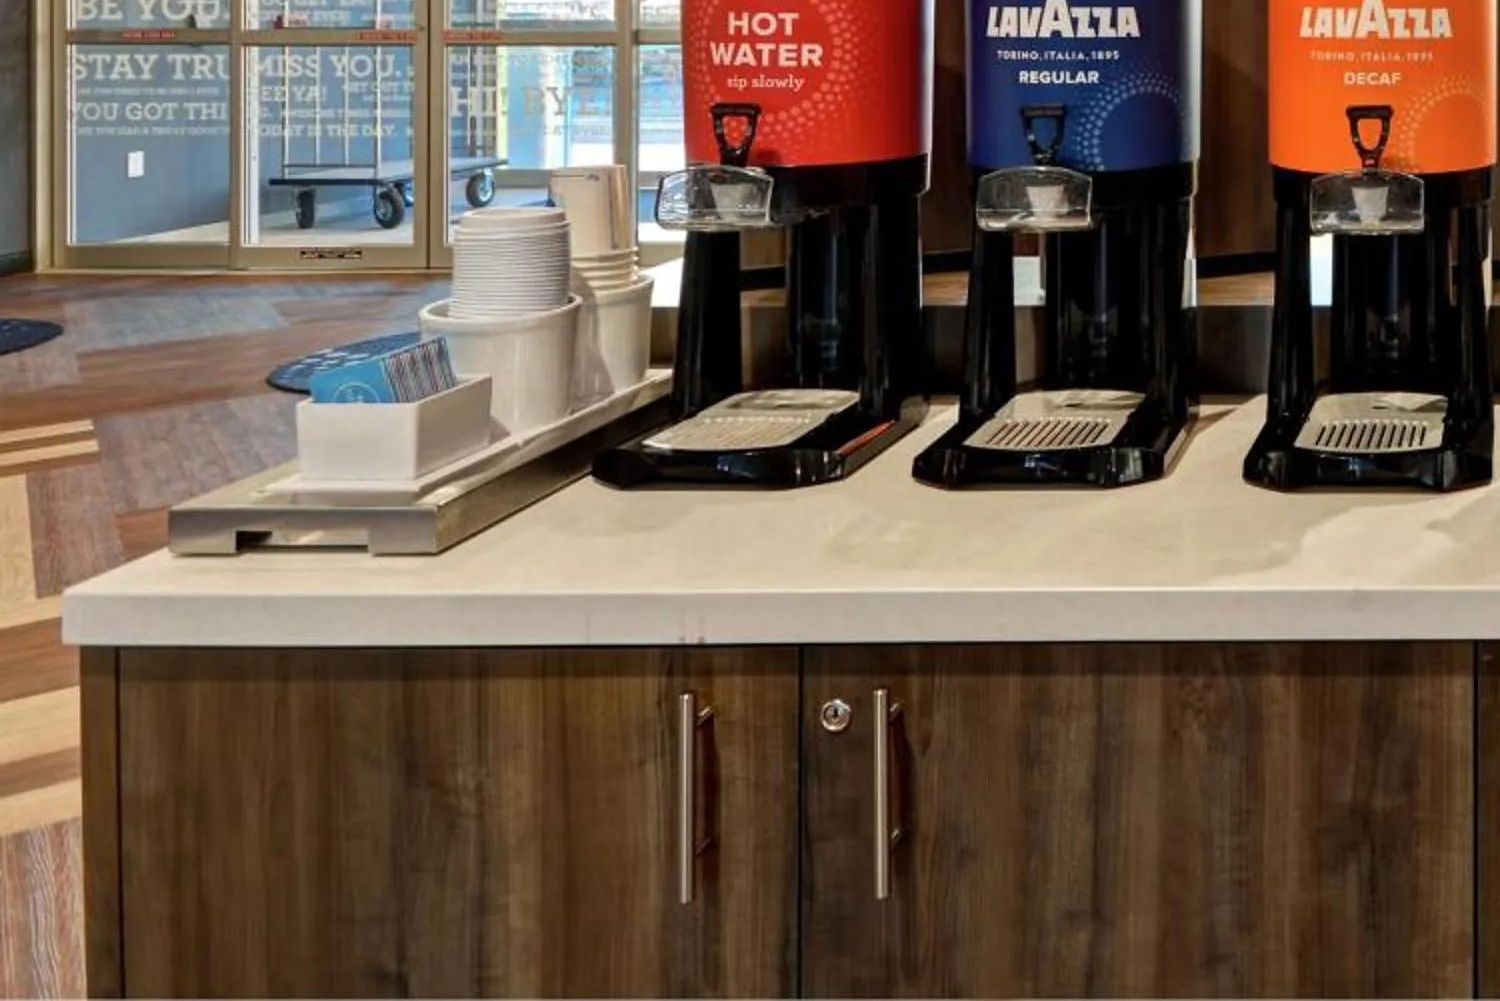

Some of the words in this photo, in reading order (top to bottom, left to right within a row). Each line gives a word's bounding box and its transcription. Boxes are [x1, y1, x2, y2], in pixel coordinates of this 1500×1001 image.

[727, 12, 799, 36] HOT
[710, 42, 823, 67] WATER
[74, 53, 159, 81] STAY
[751, 74, 804, 92] slowly
[1019, 70, 1099, 84] REGULAR
[1344, 72, 1402, 85] DECAF
[126, 101, 179, 120] GOT
